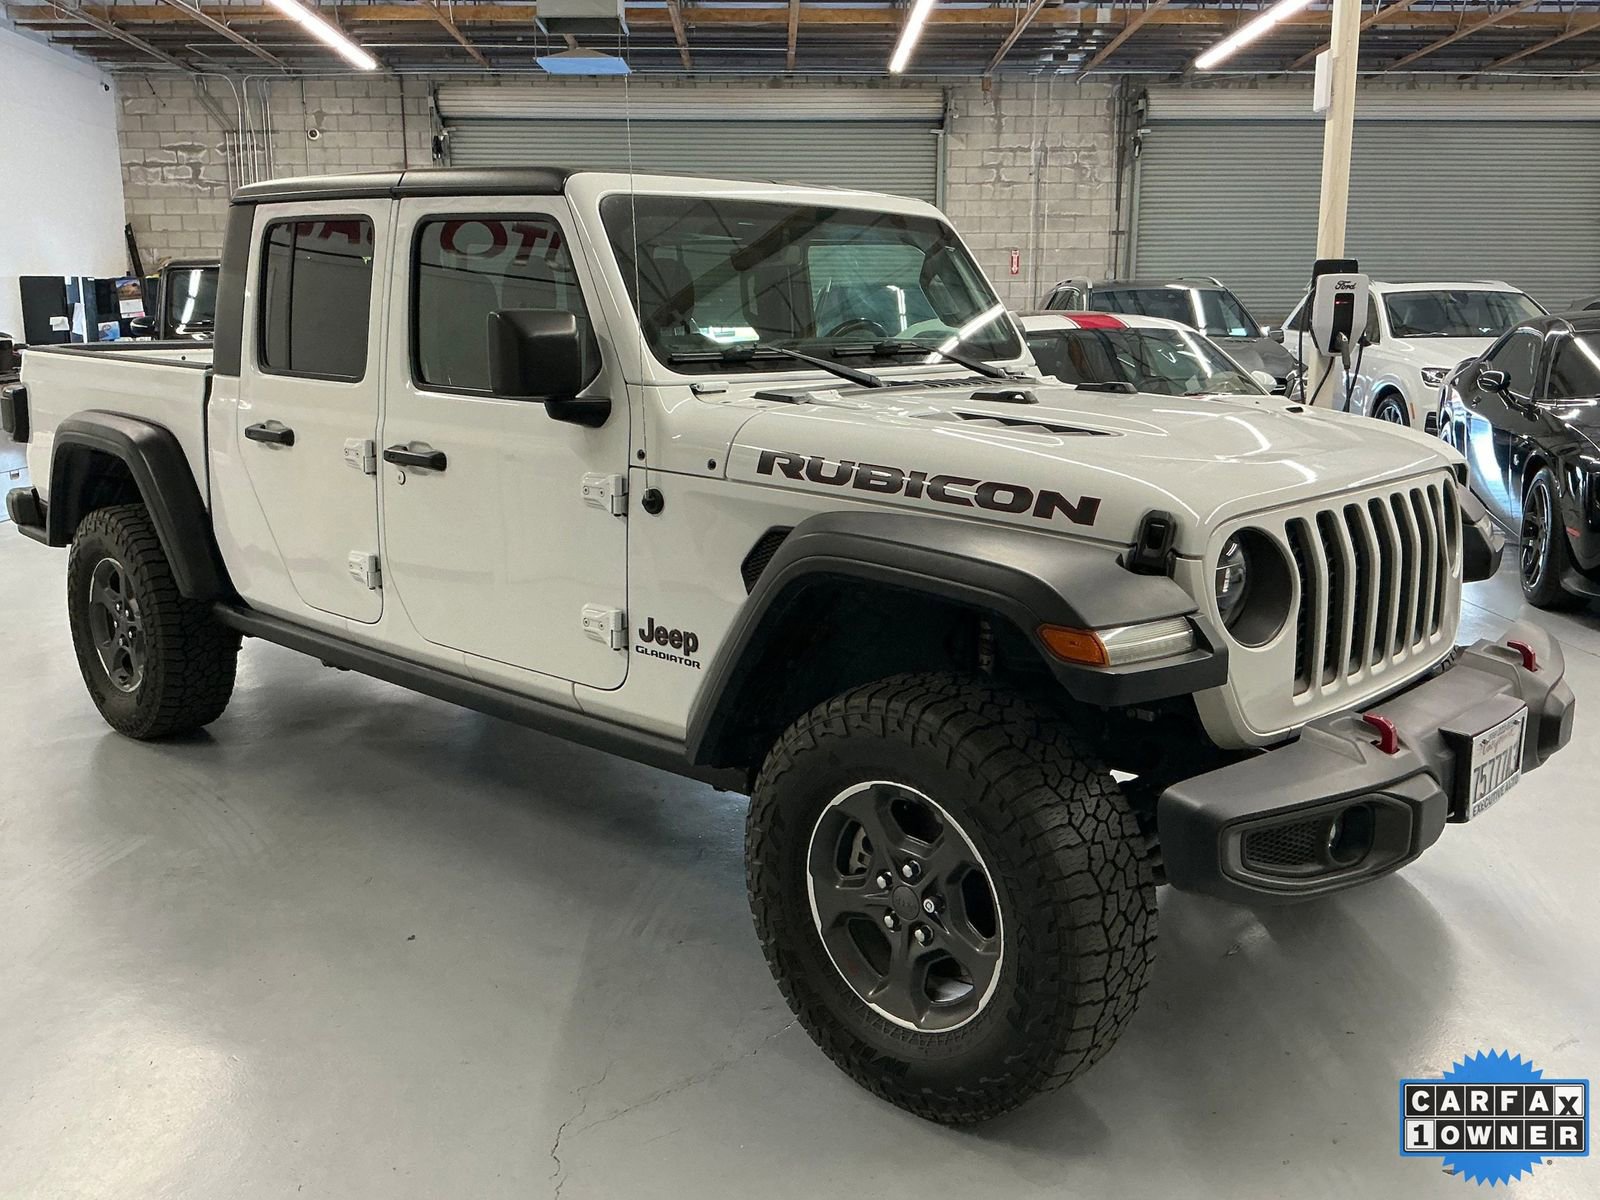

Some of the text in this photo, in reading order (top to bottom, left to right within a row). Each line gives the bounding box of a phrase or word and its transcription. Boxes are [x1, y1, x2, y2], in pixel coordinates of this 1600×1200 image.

[1335, 281, 1357, 290] Ford
[756, 450, 1102, 526] RUBICON
[638, 616, 699, 657] Jeep
[635, 645, 701, 670] GLADIATOR
